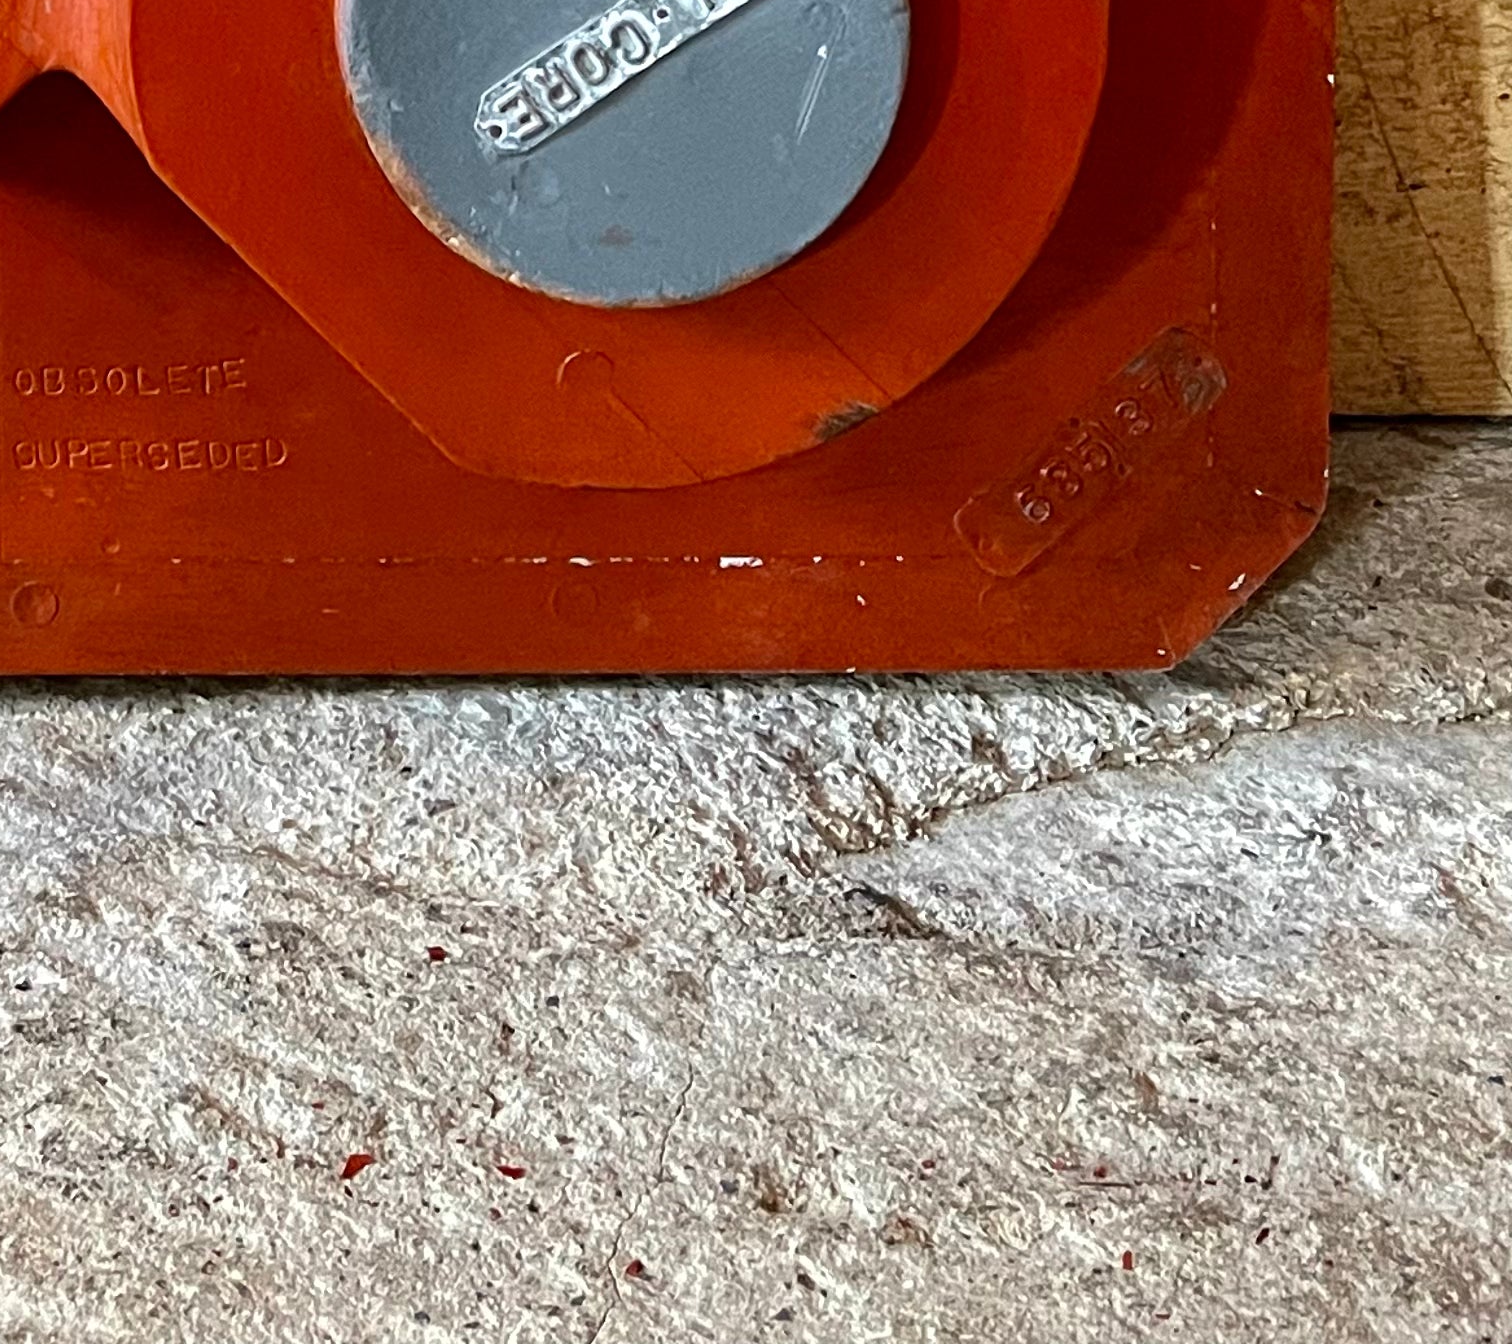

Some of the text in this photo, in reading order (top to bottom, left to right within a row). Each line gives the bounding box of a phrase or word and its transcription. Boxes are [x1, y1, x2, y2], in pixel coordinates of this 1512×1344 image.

[495, 16, 653, 142] CORE
[14, 358, 248, 395] OBSOLETE
[14, 438, 289, 471] SUPERSEDED
[1012, 365, 1179, 524] 685137
